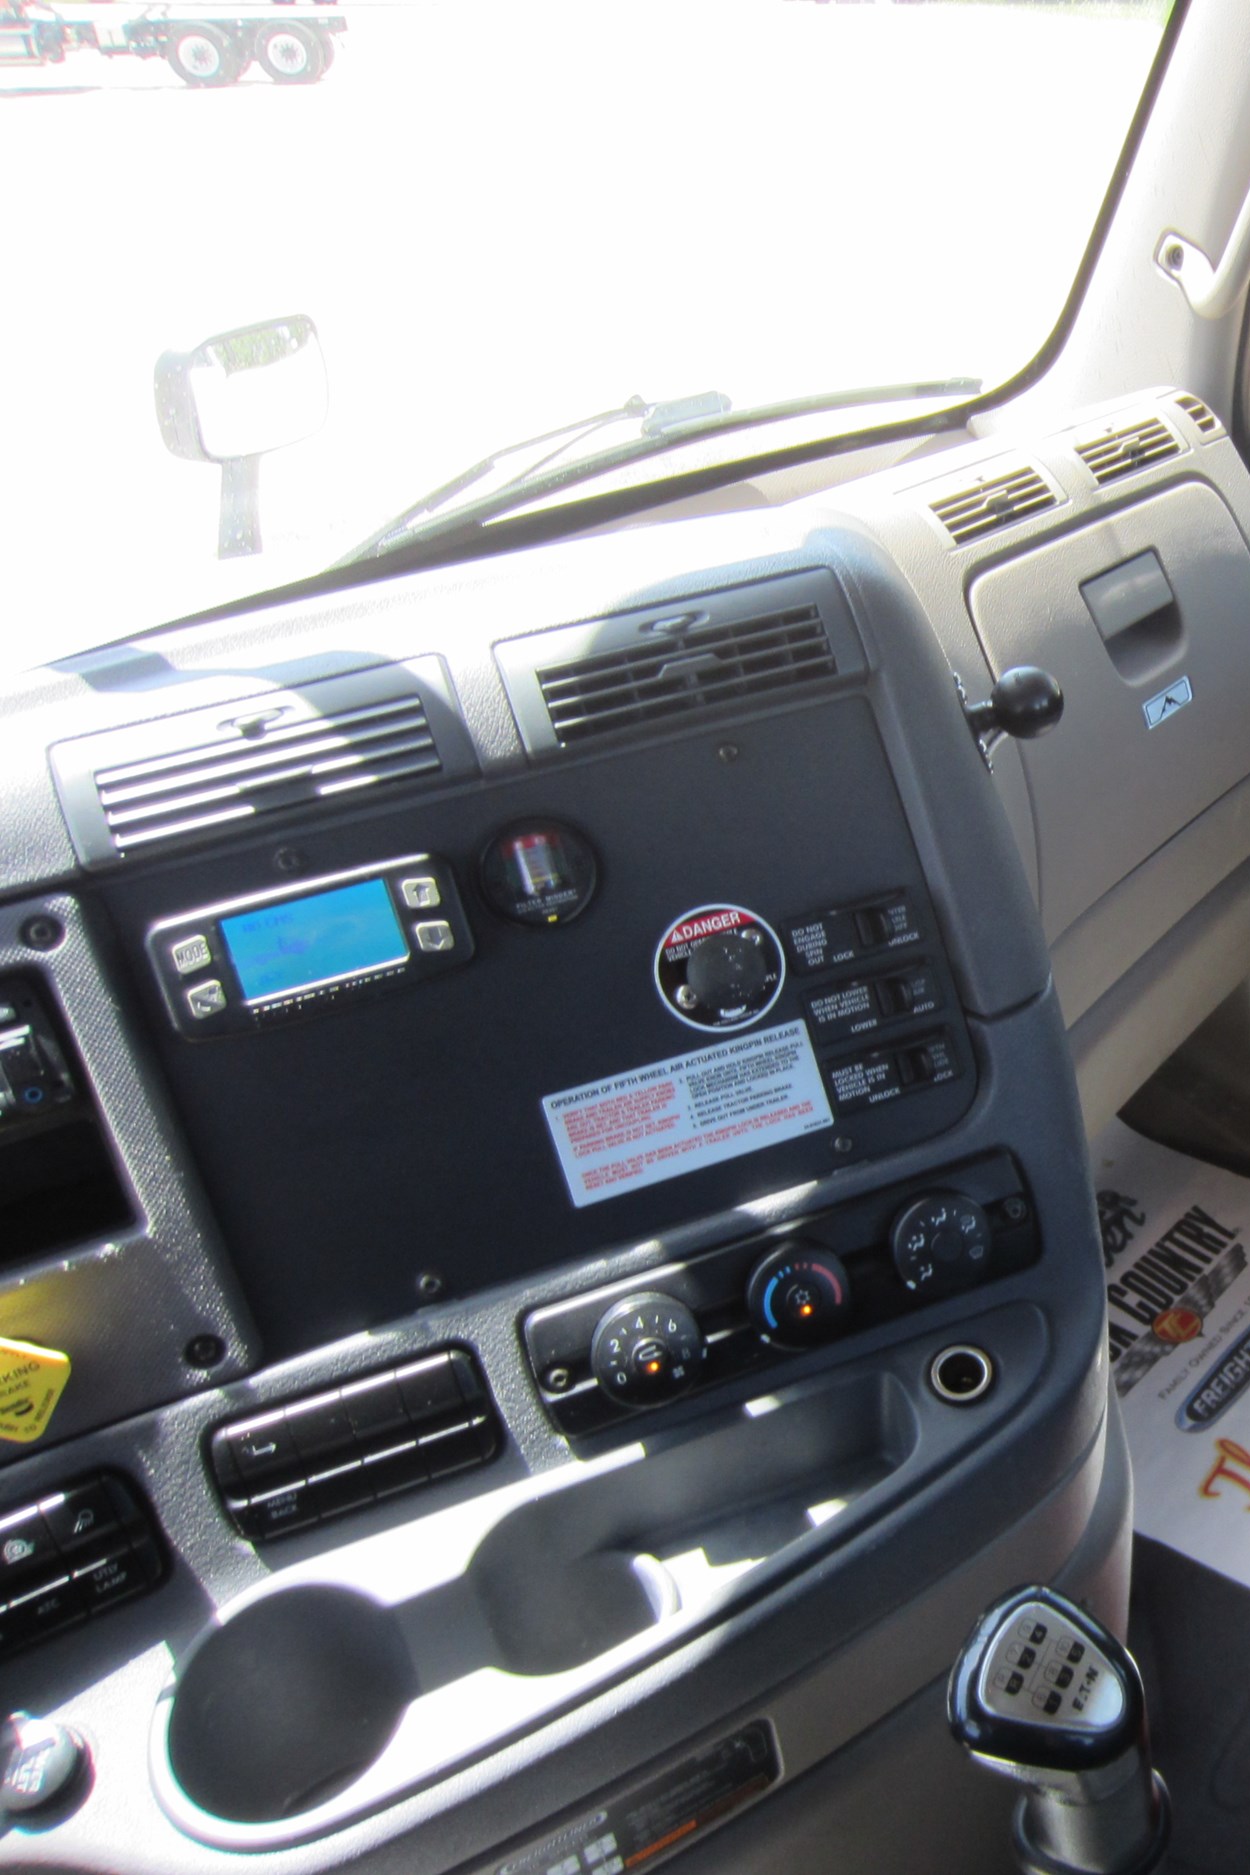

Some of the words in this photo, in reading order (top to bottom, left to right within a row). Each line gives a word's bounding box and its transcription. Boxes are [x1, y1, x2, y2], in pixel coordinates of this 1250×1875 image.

[681, 911, 742, 938] DANGER
[792, 928, 804, 938] DO
[806, 922, 823, 933] NOT
[793, 931, 826, 946] ENGAGE
[796, 939, 828, 953] DURING
[177, 944, 209, 968] MODE
[808, 956, 824, 966] OUT
[833, 950, 855, 963] LOCK
[811, 1000, 824, 1010] DO
[824, 994, 841, 1003] NOT
[842, 986, 868, 999] LOWER
[813, 1003, 838, 1017] WHEN
[839, 993, 869, 1009] VEHICLE
[818, 1015, 826, 1023] IS
[827, 1010, 837, 1020] IN
[838, 1001, 870, 1017] MOTION
[913, 1001, 935, 1014] AUTO
[851, 1018, 877, 1034] LOWER
[549, 1088, 600, 1109] OPERATION
[600, 1084, 612, 1094] OF
[613, 1076, 638, 1090] FIFTH
[638, 1067, 667, 1082] WHEEL
[668, 1062, 684, 1073] AIR
[684, 1048, 728, 1068] ACTUATED
[728, 1038, 762, 1055] KINGPIN
[762, 1026, 800, 1044] RELEASE
[832, 1066, 852, 1079] MUST
[854, 1062, 863, 1072] BE
[834, 1071, 864, 1086] LOCKED
[865, 1063, 889, 1077] WHEN
[836, 1080, 867, 1094] VEHICLE
[867, 1076, 876, 1084] IS
[876, 1071, 886, 1081] IN
[838, 1086, 870, 1102] MOTION
[868, 1087, 900, 1104] UNLOCK
[1107, 1205, 1236, 1327] COUNTRY
[635, 1316, 645, 1329] 4
[667, 1318, 677, 1332] 6
[609, 1338, 621, 1353] 2
[1188, 1334, 1222, 1368] OWNED
[1218, 1308, 1247, 1335] SINCE
[616, 1373, 628, 1386] 0
[270, 1506, 298, 1520] BACK
[95, 1571, 128, 1594] LAMP
